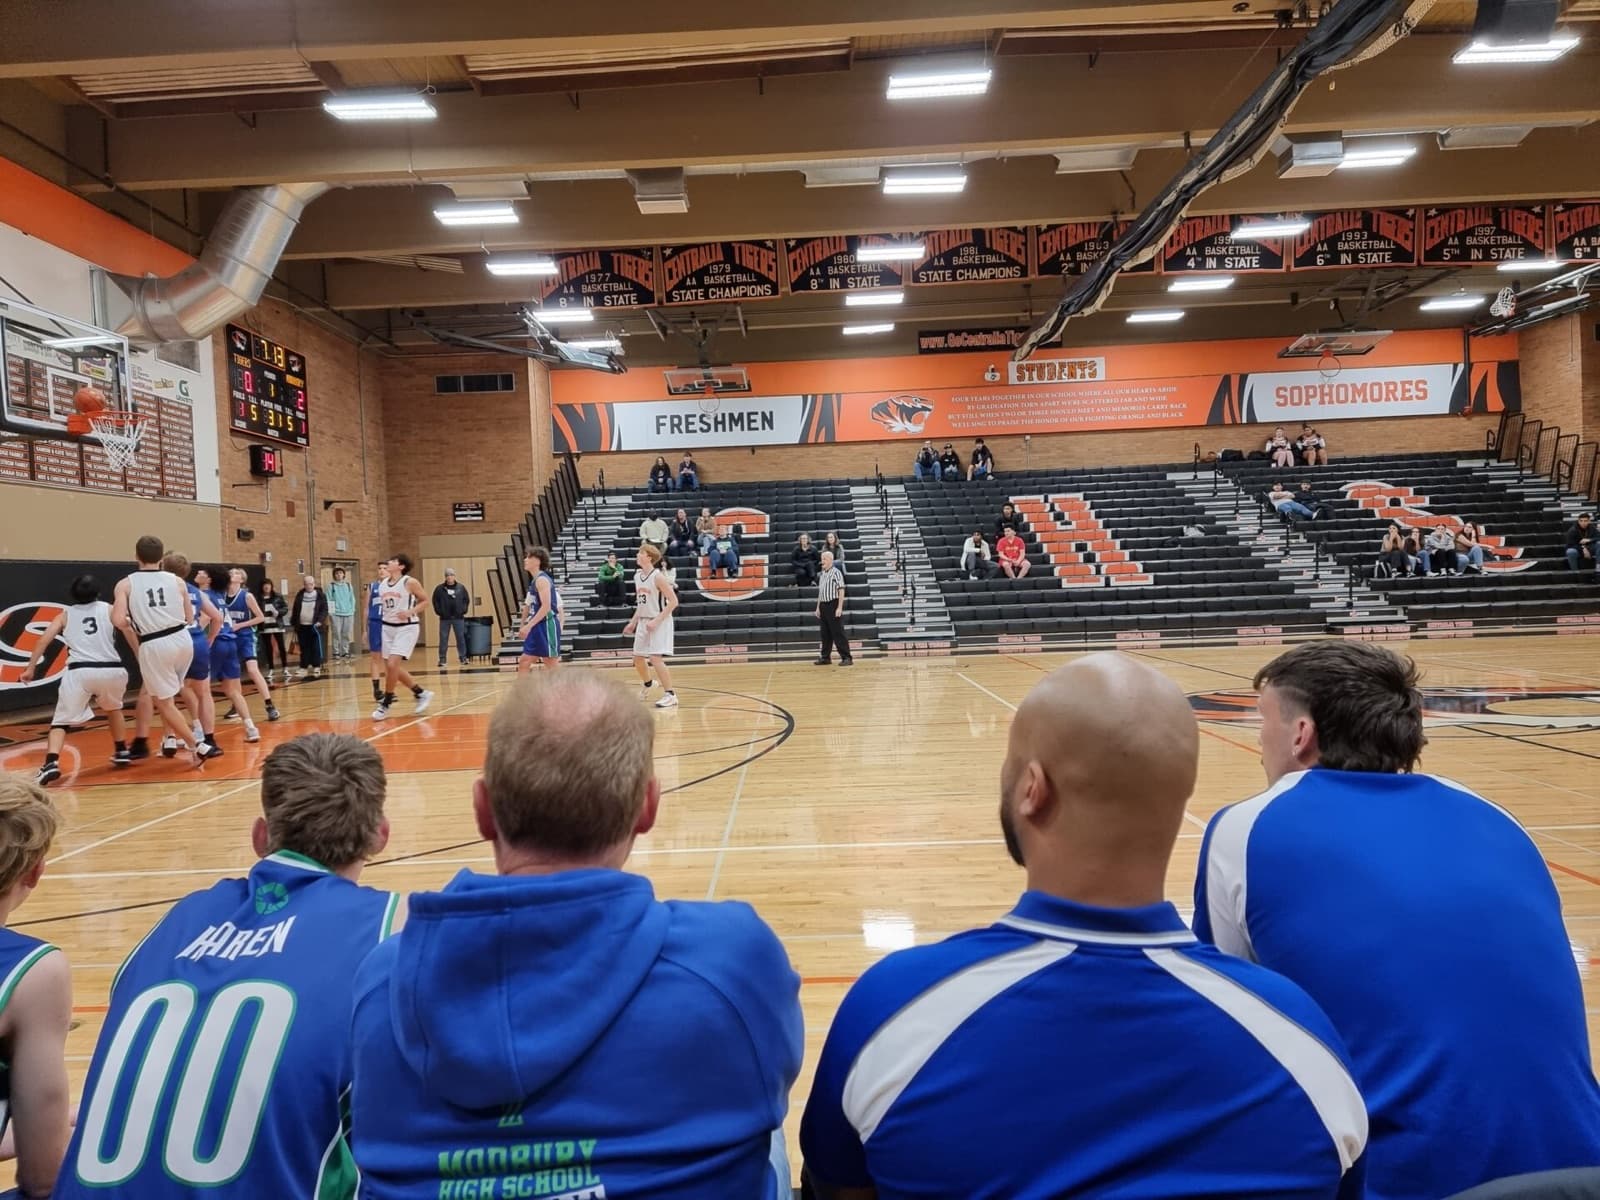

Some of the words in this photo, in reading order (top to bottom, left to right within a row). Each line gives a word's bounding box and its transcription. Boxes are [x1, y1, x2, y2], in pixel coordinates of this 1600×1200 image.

[1369, 210, 1412, 252] TIGERS
[1426, 206, 1493, 251] CENTRALIA
[1499, 208, 1543, 250] TIGERS
[1475, 227, 1496, 235] 1997
[1342, 232, 1368, 240] 1993
[1466, 236, 1523, 245] BASKETBALL
[1574, 237, 1586, 246] AA
[960, 247, 978, 255] 1981
[984, 228, 1026, 265] TIGERS
[1205, 246, 1261, 255] BASKETBALL
[1338, 240, 1396, 250] BASKETBALL
[789, 236, 847, 282] CENTRALIA
[953, 254, 1006, 265] BASKETBALL
[1341, 253, 1351, 264] IN
[1359, 252, 1392, 264] STATE
[1443, 248, 1459, 260] 5TH
[1471, 248, 1482, 259] IN
[1490, 248, 1525, 259] STATE
[664, 243, 724, 292] CENTRALIA
[732, 243, 776, 282] TIGERS
[709, 264, 730, 273] 1979
[1206, 257, 1216, 268] IN
[1225, 257, 1259, 268] STATE
[611, 253, 654, 292] TIGERS
[828, 264, 882, 274] BASKETBALL
[919, 270, 952, 282] STATE
[957, 266, 1020, 280] CHAMPIONS
[586, 274, 610, 283] 1977
[704, 273, 757, 284] BASKETBALL
[830, 278, 839, 288] IN
[848, 276, 880, 288] STATE
[582, 283, 633, 293] BASKETBALL
[672, 289, 704, 302] STATE
[709, 284, 771, 299] CHAMPIONS
[584, 296, 594, 306] IN
[604, 294, 638, 306] STATE
[1016, 360, 1097, 382] STUDENTS
[1275, 380, 1428, 408] SOPHOMORES
[656, 410, 774, 434] FRESHMEN
[696, 507, 770, 601] C
[1009, 492, 1154, 588] H
[1340, 480, 1538, 572] S
[146, 587, 167, 607] 11
[82, 616, 98, 635] 3
[75, 979, 296, 1188] 00
[438, 1139, 597, 1177] MODBURY
[438, 1178, 496, 1200] HIGH
[502, 1166, 600, 1200] SCHOOL
